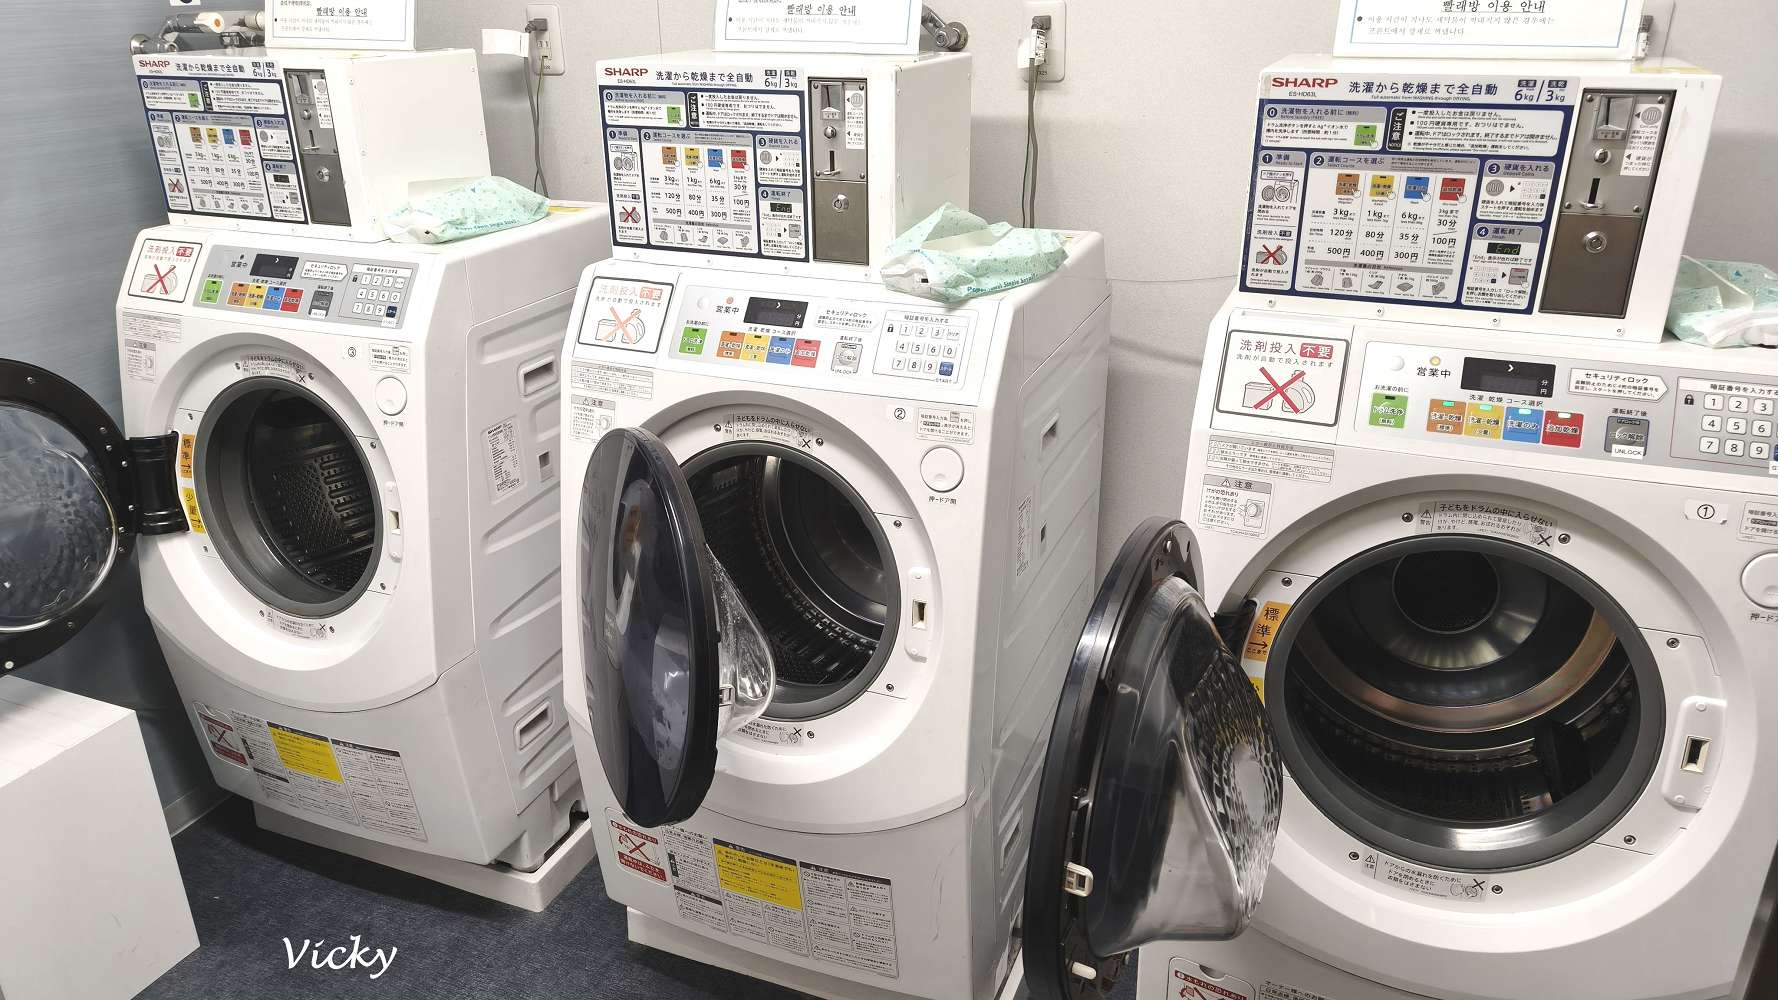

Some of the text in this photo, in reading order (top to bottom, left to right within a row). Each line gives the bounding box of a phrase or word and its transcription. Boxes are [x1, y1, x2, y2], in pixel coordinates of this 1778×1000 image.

[786, 5, 856, 16] 빨래방 이용 안내
[1443, 0, 1545, 13] 빨래방 이용 안내
[355, 8, 368, 16] 안내
[139, 60, 170, 68] SHARP
[176, 63, 245, 73] 洗濯から乾燥まで全自動
[605, 67, 648, 77] SHARP
[656, 70, 753, 83] 洗濯から乾燥まで全自動
[1272, 78, 1338, 88] SHARP
[1348, 82, 1498, 97] 洗濯から乾燥まで全自動
[1514, 90, 1534, 101] 6kg
[1546, 90, 1565, 102] 3kg
[1281, 108, 1344, 116] 洗濯物を入れる前に
[1328, 157, 1384, 165] 運転コースを選ぶ
[1504, 164, 1549, 172] 硬貨を入れる
[733, 199, 749, 207] 100円
[665, 207, 681, 215] 500円
[688, 209, 704, 217] 400円
[711, 211, 727, 219] 300円
[1437, 219, 1457, 227] 30分
[1330, 228, 1353, 237] 120分
[1366, 231, 1384, 239] 80分
[1492, 227, 1523, 236] 運転終了
[1399, 233, 1419, 241] 35分
[1432, 237, 1456, 246] 100円
[1327, 247, 1350, 256] 500円
[1360, 250, 1384, 258] 400円
[1496, 245, 1520, 254] End
[1394, 251, 1418, 260] 300円
[716, 305, 739, 314] 営業中
[826, 310, 867, 318] セキュリティロック
[904, 314, 949, 323] 暗証番号を入力する
[1240, 339, 1332, 358] 洗剤投入 不要
[1236, 354, 1333, 368] 洗剤が自動で投入されます
[1416, 367, 1451, 378] 営業中
[1585, 373, 1648, 384] セキュリティロック
[1374, 384, 1408, 393] お洗濯の前に
[1710, 383, 1778, 396] 暗証番号を入力する
[1506, 398, 1544, 407] コース選択
[1735, 401, 1742, 409] 2
[1761, 403, 1767, 411] 3
[1612, 408, 1647, 416] 運転終了後
[1734, 422, 1740, 430] 5
[1758, 425, 1765, 433] 6
[1706, 441, 1713, 449] 7
[1731, 444, 1737, 452] 8
[1614, 448, 1642, 456] UNLOCK
[1756, 446, 1763, 455] 9
[1234, 480, 1253, 489] 注意
[1440, 504, 1553, 527] 子どもをドラムの中に入らせない
[1256, 607, 1280, 637] 標準
[1385, 860, 1463, 883] ドアからの水漏れを防ぐために
